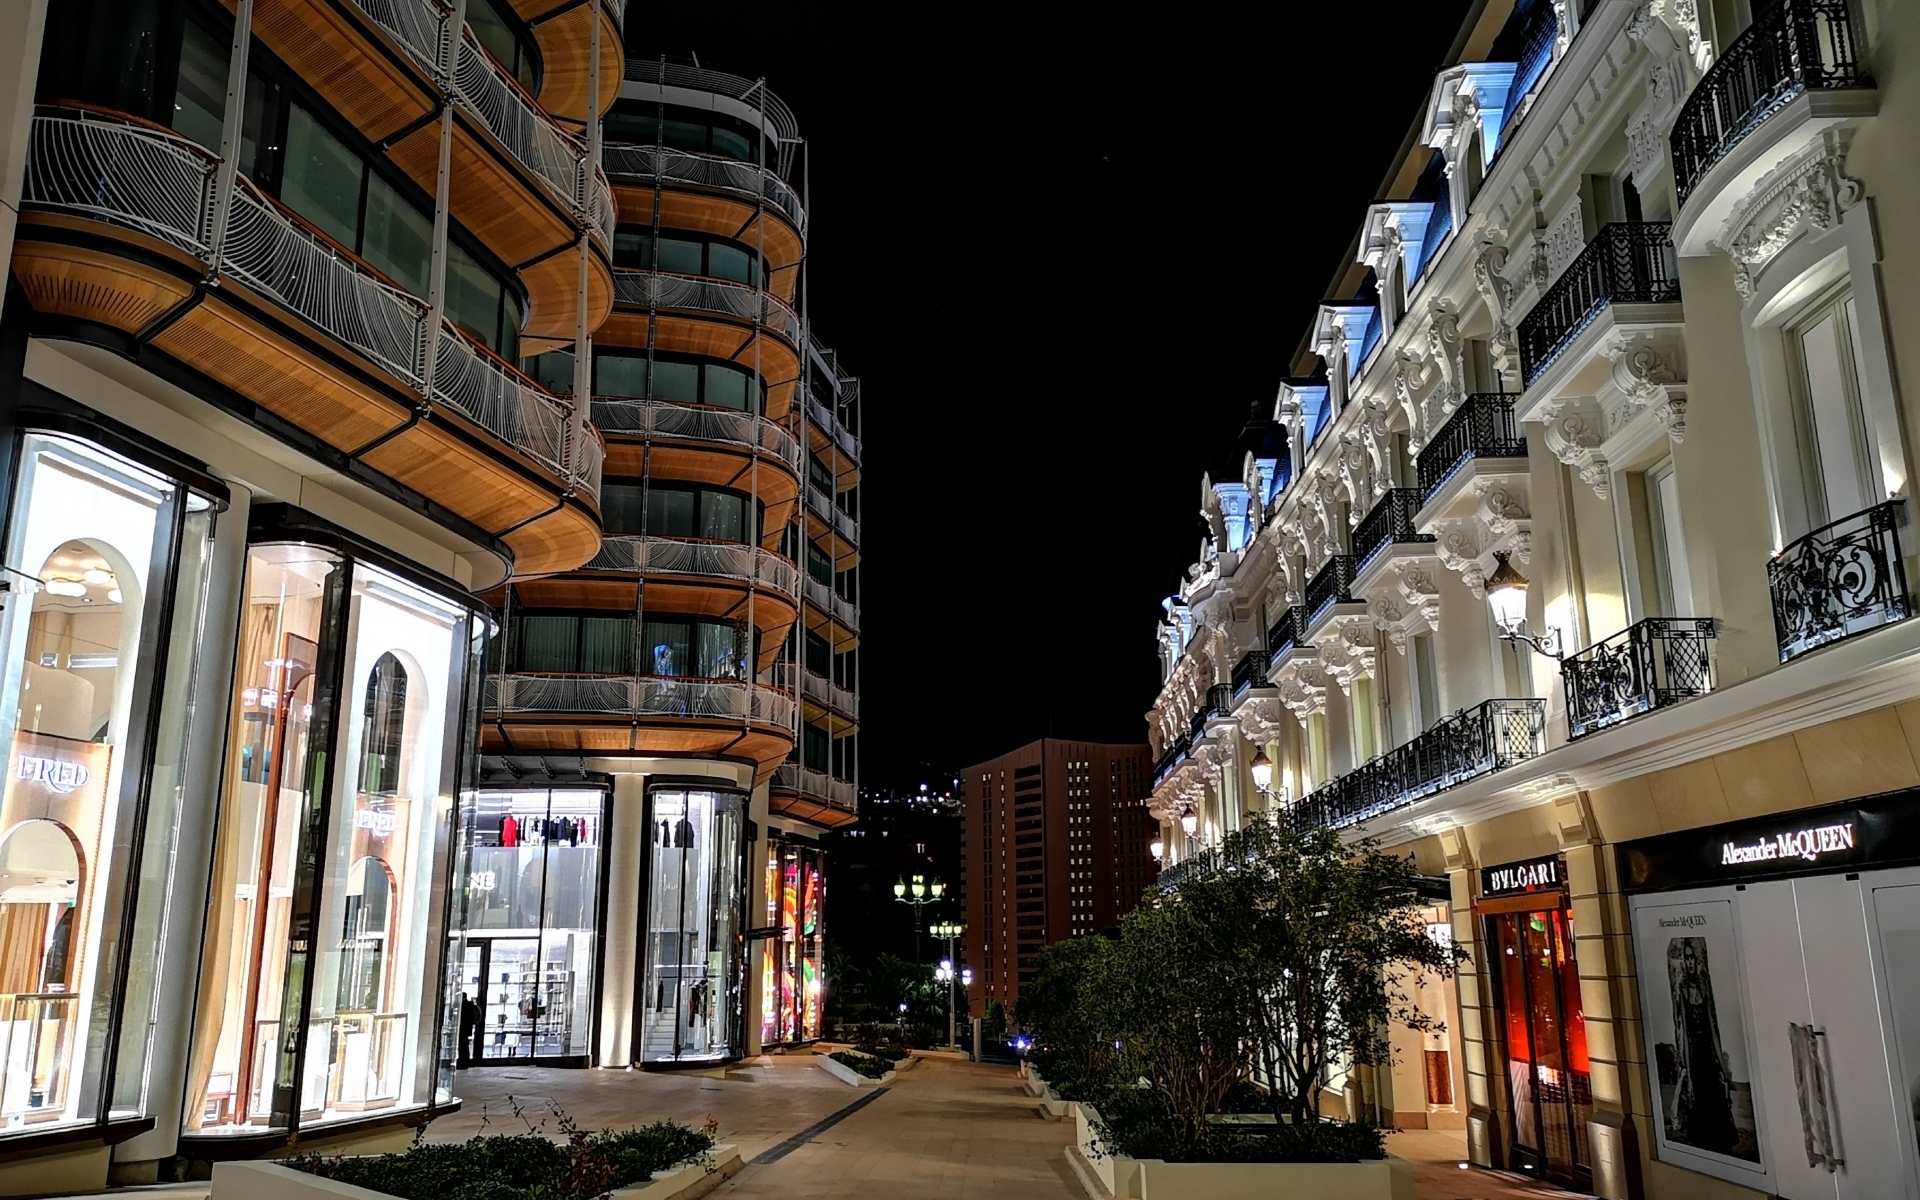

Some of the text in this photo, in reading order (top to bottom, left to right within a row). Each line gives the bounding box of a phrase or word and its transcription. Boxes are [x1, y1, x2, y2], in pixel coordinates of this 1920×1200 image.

[17, 754, 89, 793] FRED
[1721, 823, 1853, 865] Alexander McQUEEN
[1491, 861, 1556, 891] BVLGARI
[1658, 915, 1707, 929] Alexander McQUEEN
